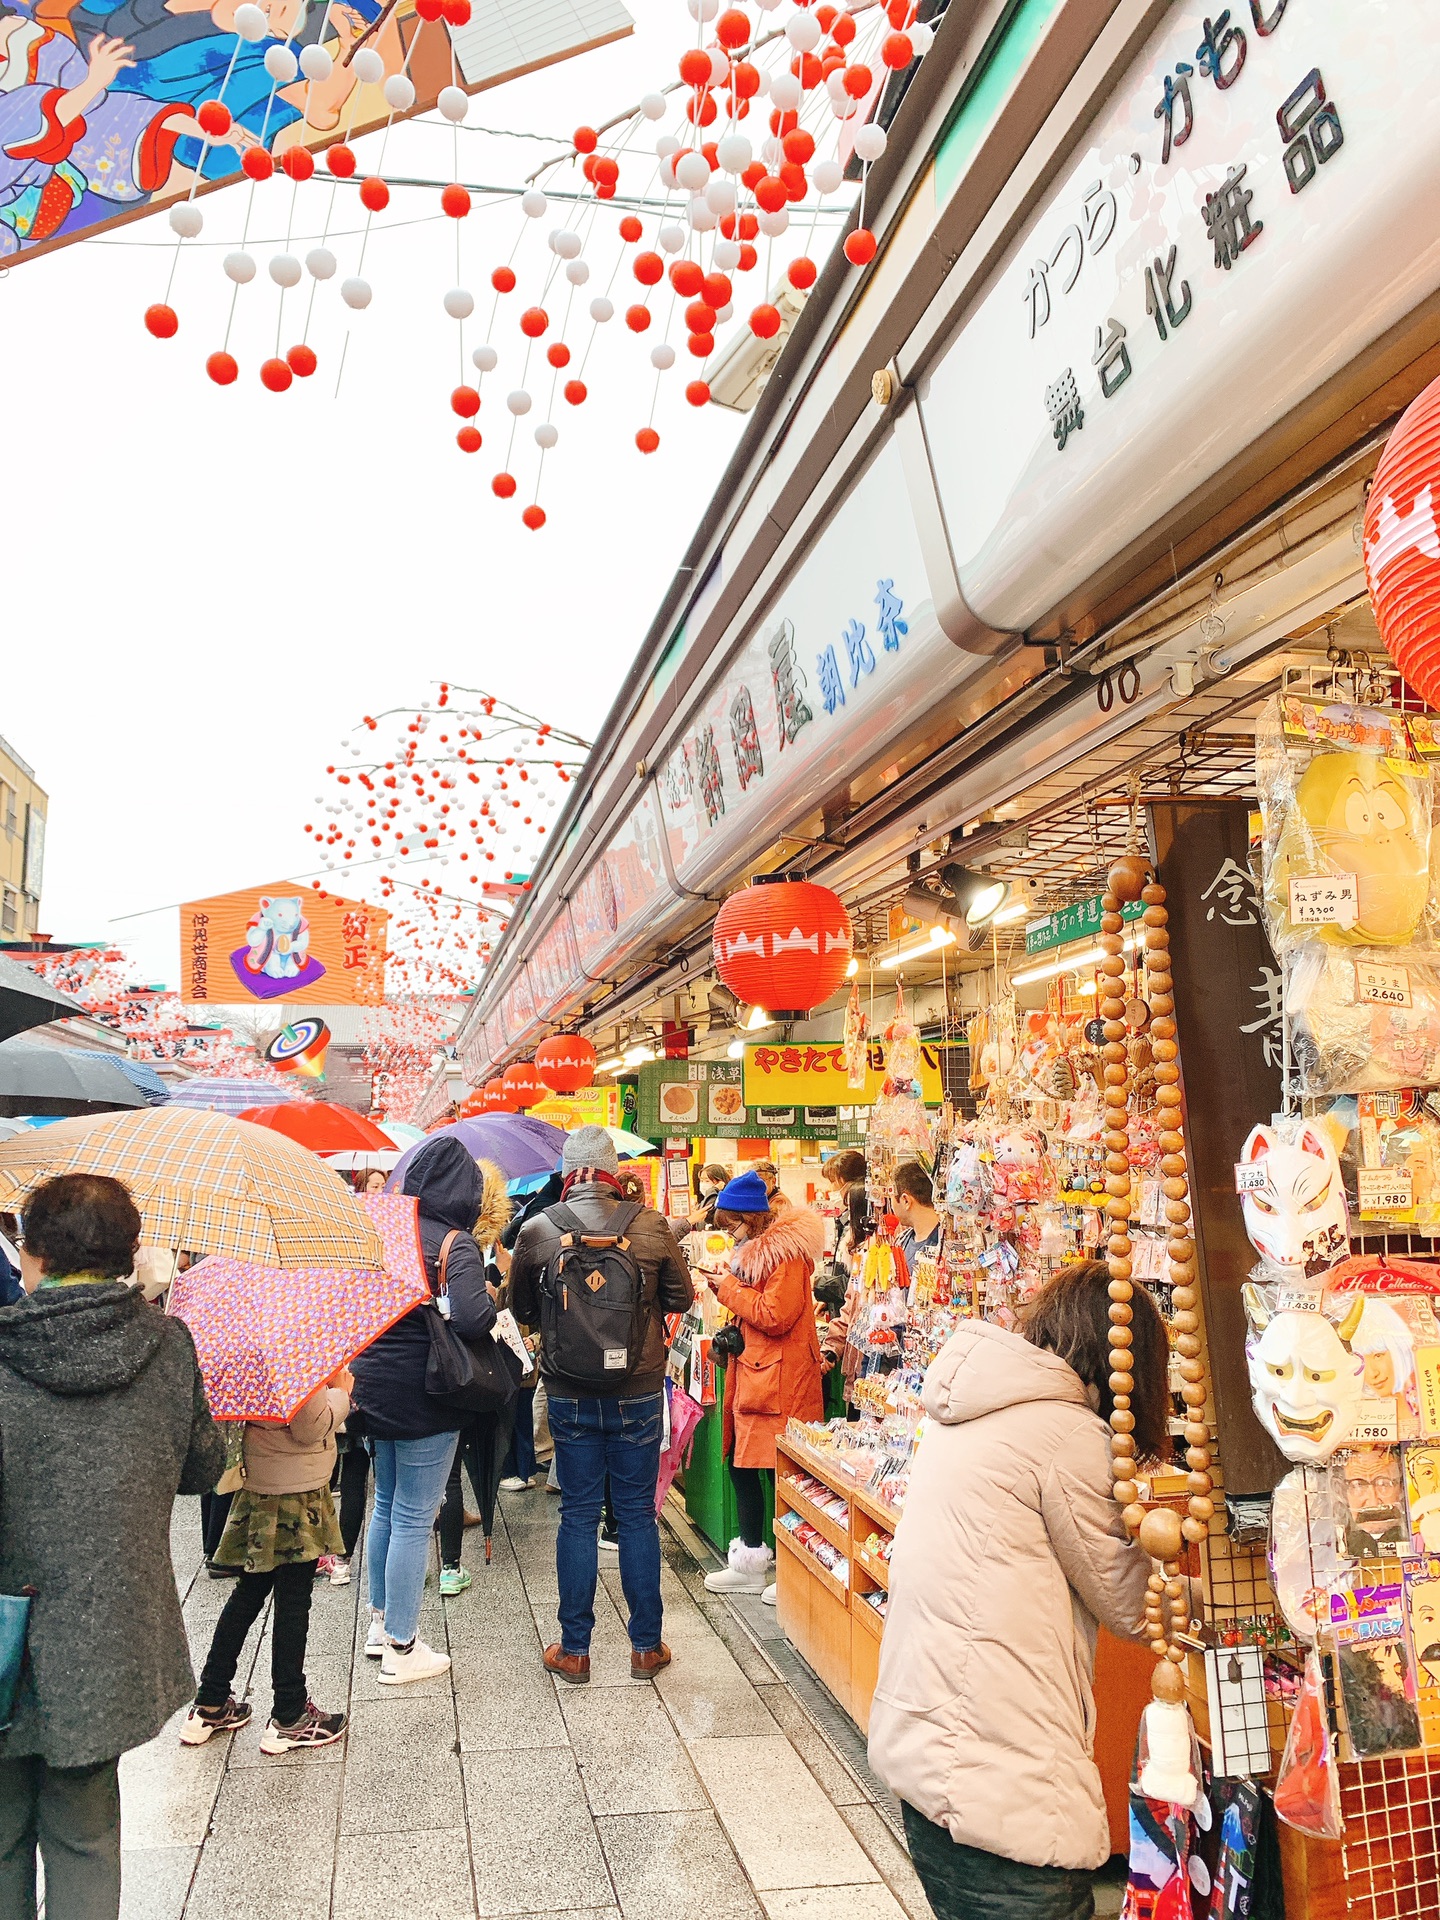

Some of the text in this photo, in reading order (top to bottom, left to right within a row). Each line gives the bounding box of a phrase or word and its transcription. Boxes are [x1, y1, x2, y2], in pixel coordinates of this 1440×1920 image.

[1042, 67, 1344, 451] 舞台化粧品
[815, 578, 908, 715] 朝比奈
[1294, 888, 1352, 902] ねずみ男
[191, 912, 209, 999] 仲見世商店会
[342, 912, 369, 971] 賀正
[1367, 974, 1400, 988] 白うま
[754, 1046, 849, 1074] やきたて
[1340, 1272, 1434, 1291] Hair Collection
